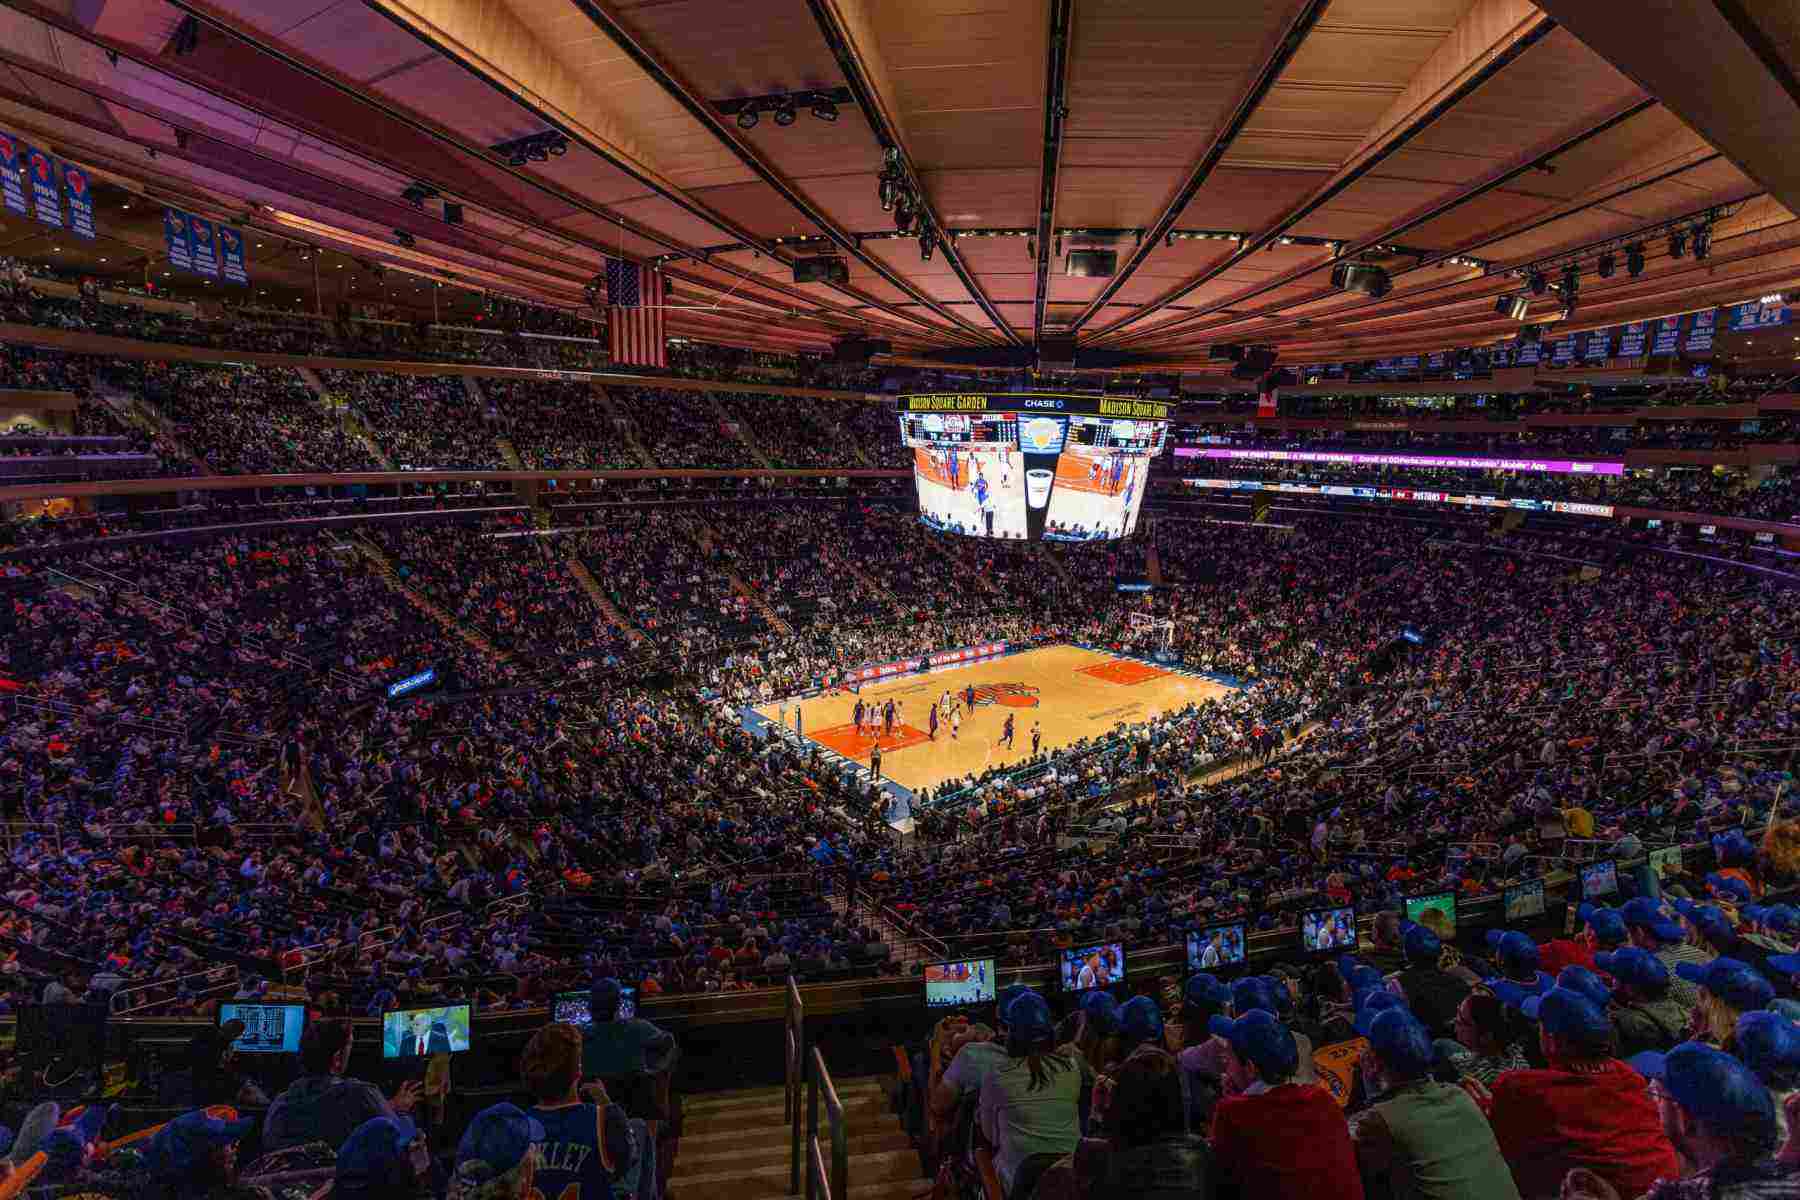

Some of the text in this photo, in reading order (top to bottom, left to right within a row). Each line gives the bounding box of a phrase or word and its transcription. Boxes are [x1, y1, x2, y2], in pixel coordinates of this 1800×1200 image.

[957, 395, 988, 410] GARDEN
[1024, 399, 1056, 409] CHASE
[1099, 399, 1131, 416] MADISON
[1531, 463, 1547, 471] App
